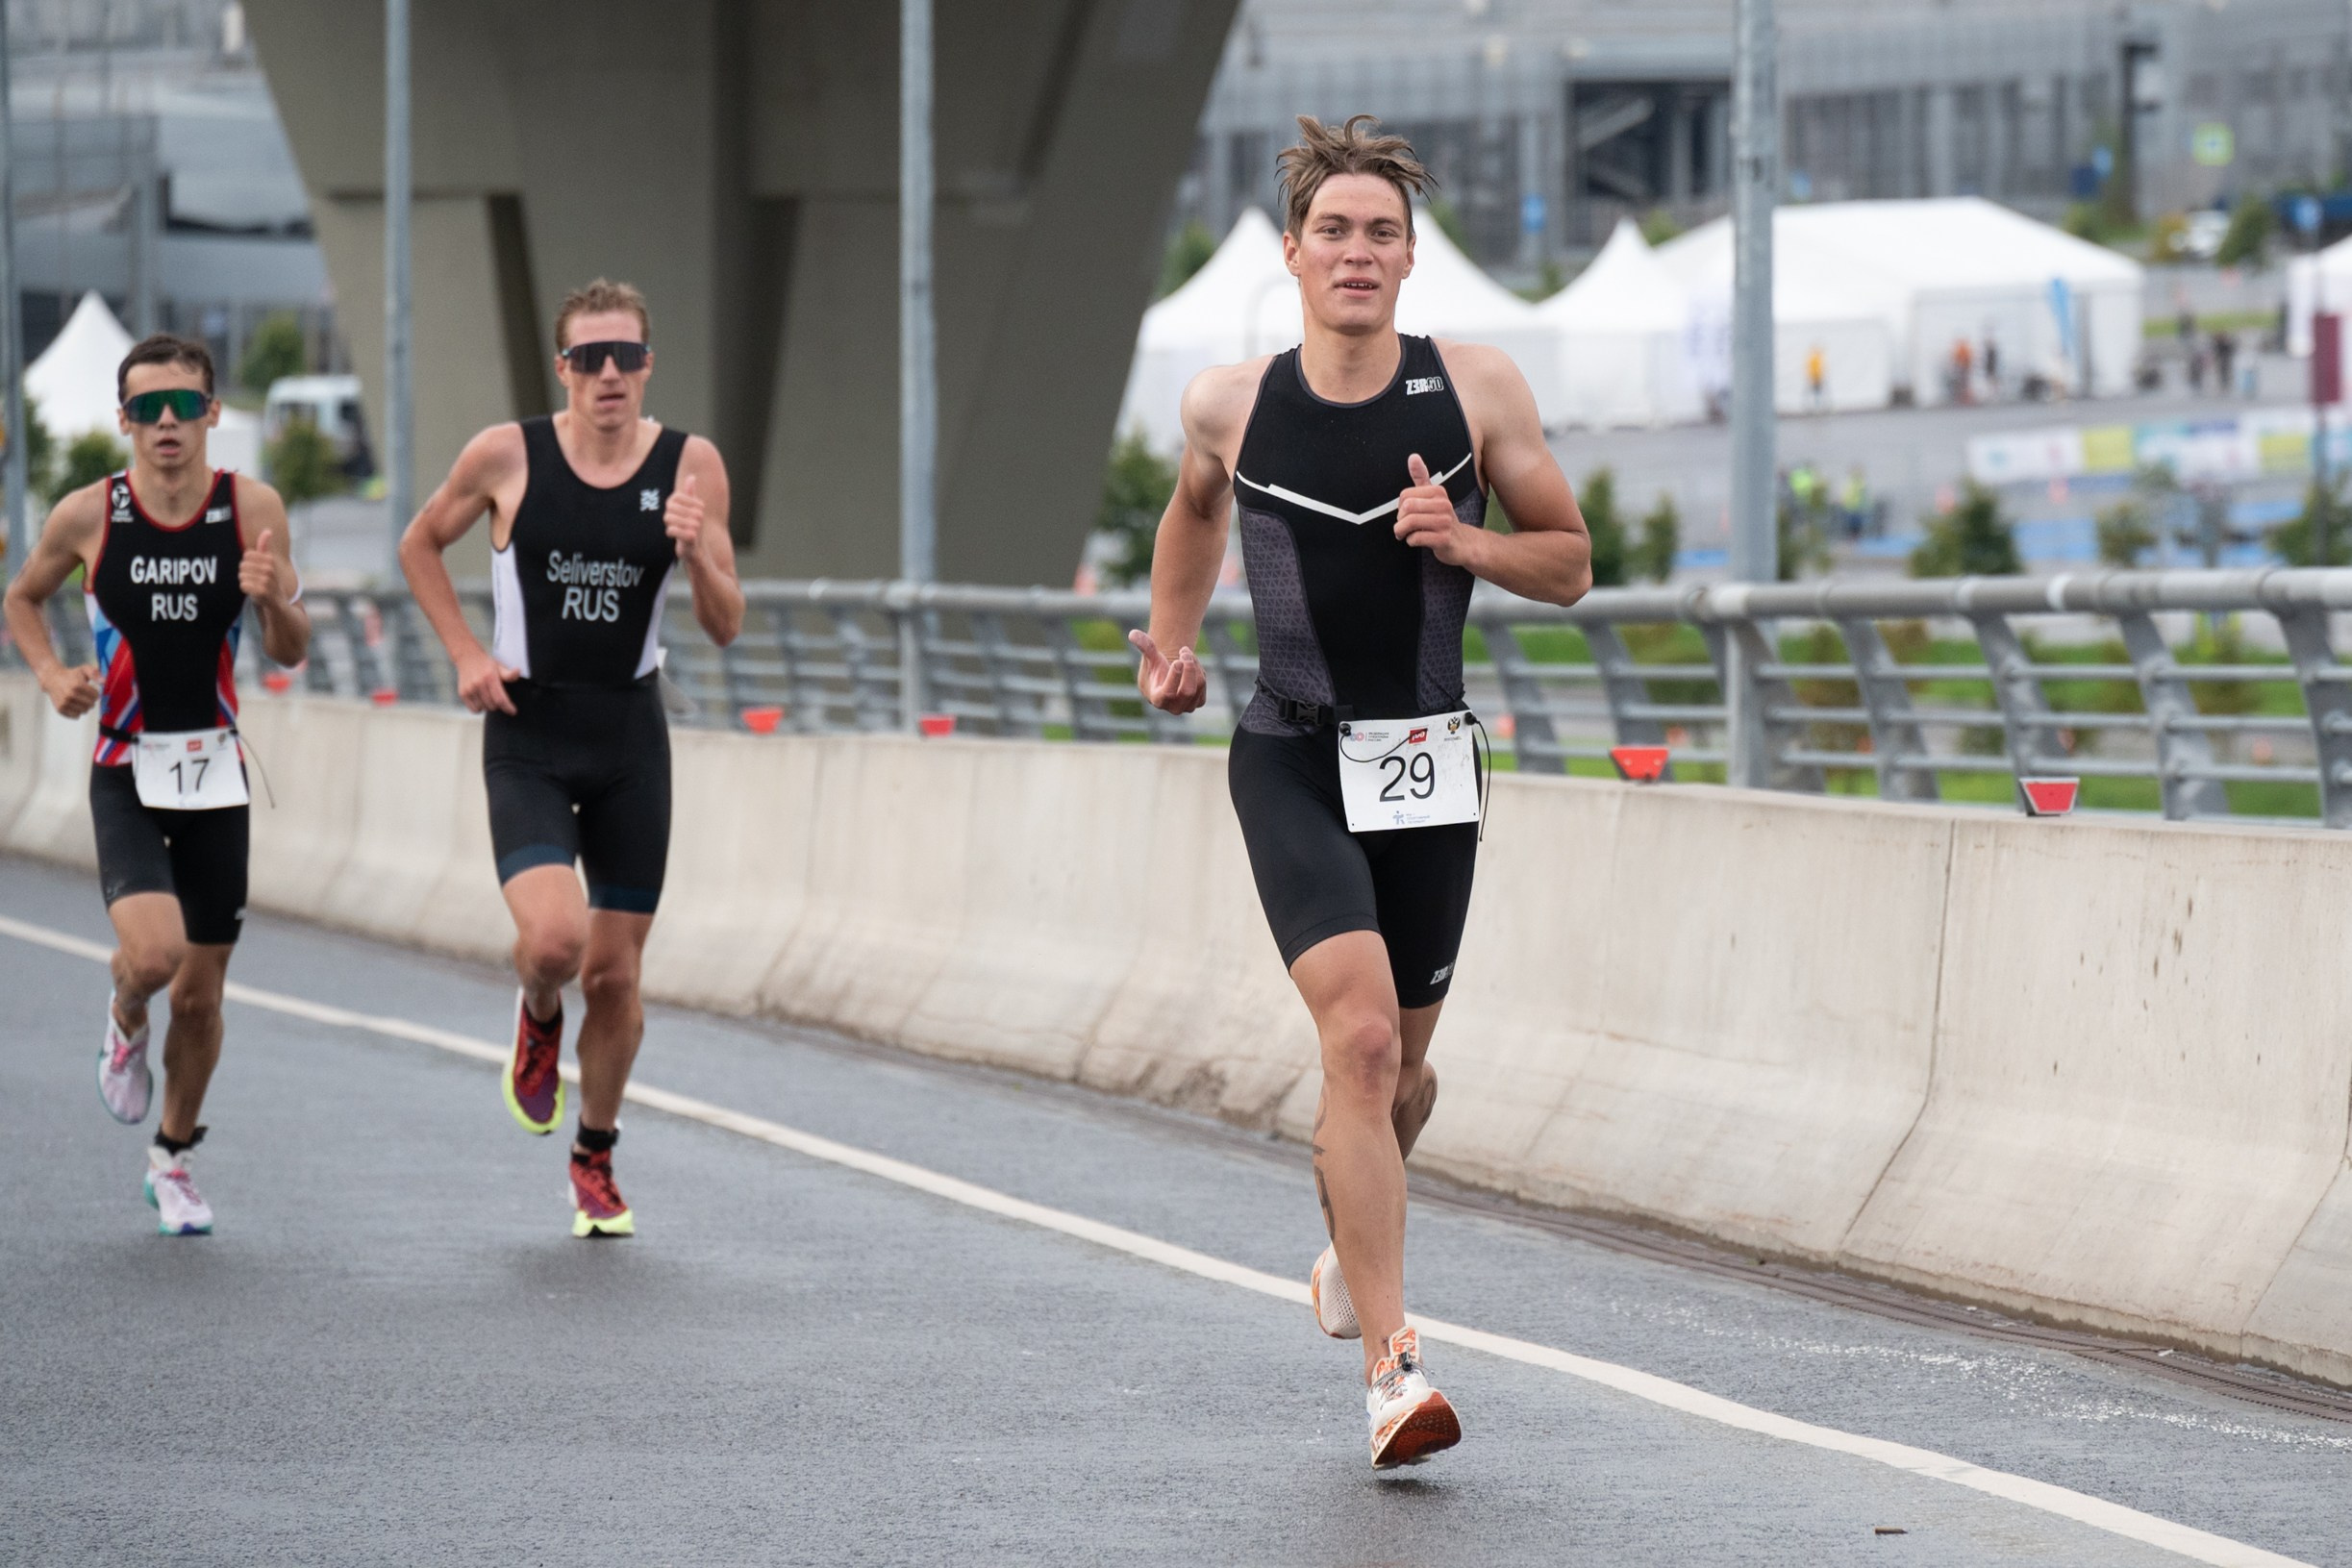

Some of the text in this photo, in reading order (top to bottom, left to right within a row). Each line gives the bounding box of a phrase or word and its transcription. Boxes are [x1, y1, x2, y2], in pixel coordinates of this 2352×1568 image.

[130, 556, 217, 585] GARIPOV
[546, 549, 645, 587] Seliverstov
[151, 592, 198, 622] RUS
[562, 585, 620, 622] RUS
[169, 758, 210, 794] 17
[1378, 752, 1436, 802] 29
